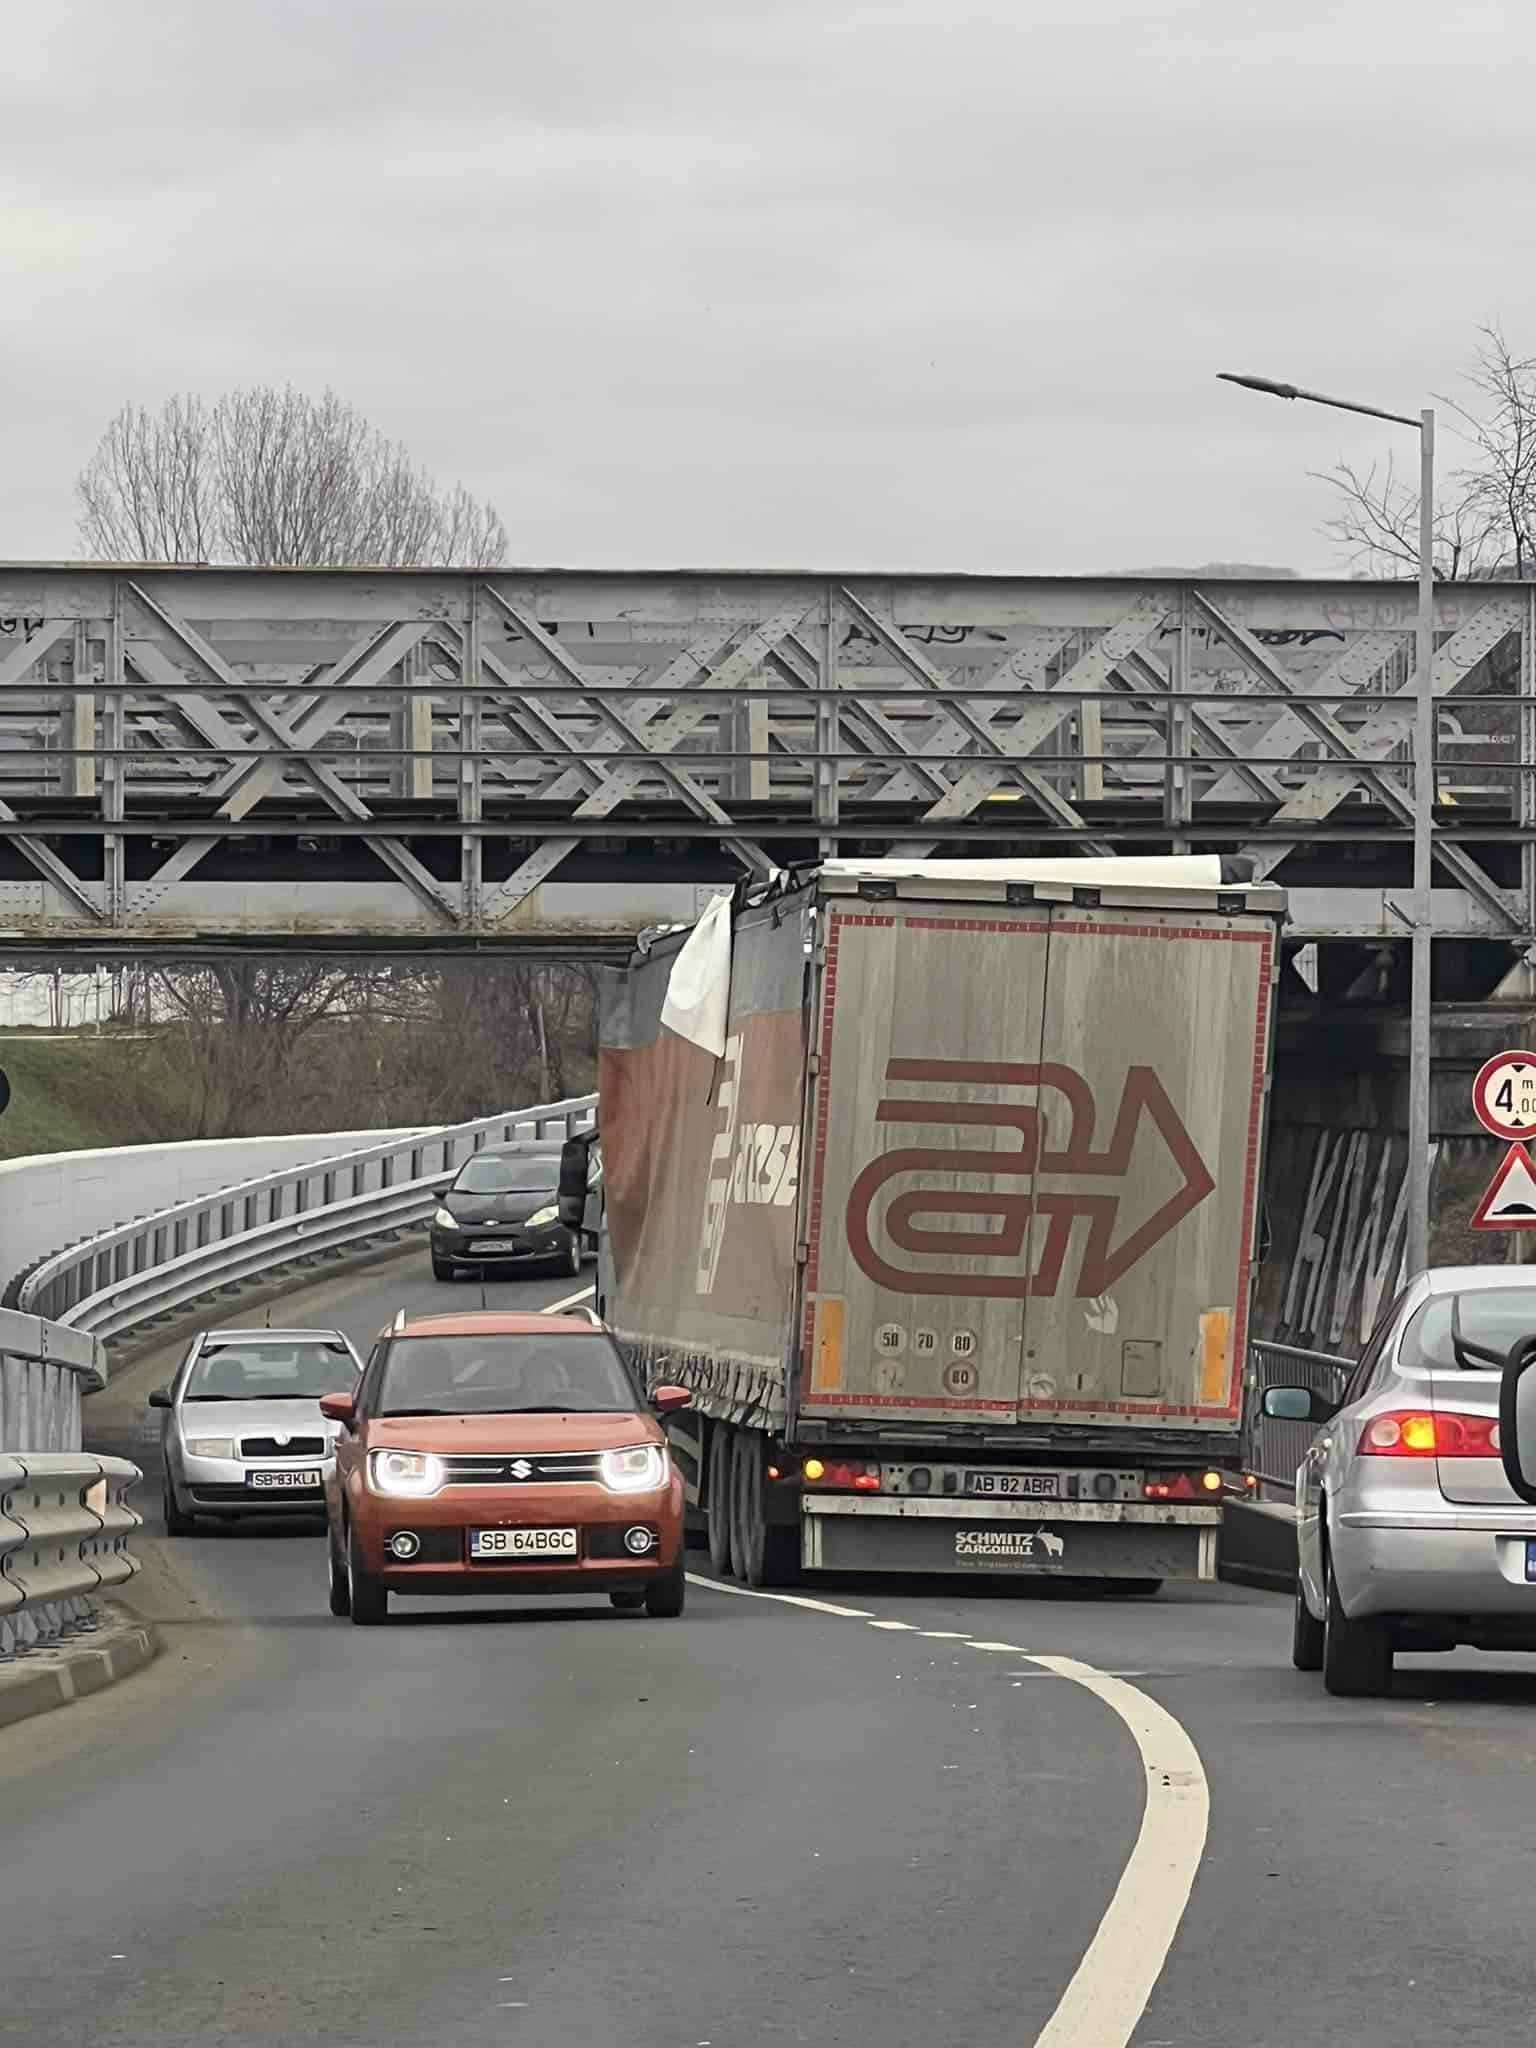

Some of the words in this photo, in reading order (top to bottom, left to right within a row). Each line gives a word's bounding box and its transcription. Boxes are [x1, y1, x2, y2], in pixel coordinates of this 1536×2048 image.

[1495, 1079, 1513, 1113] 4
[883, 1332, 899, 1347] 50
[918, 1333, 934, 1349] 70
[954, 1335, 971, 1351] 80
[255, 1474, 273, 1486] SB
[975, 1476, 995, 1492] AB
[1001, 1478, 1019, 1493] 82
[1023, 1479, 1054, 1494] ABR
[481, 1533, 507, 1550] SB
[955, 1531, 1034, 1546] SCHMITZ
[955, 1544, 1033, 1555] CARGOBULL
